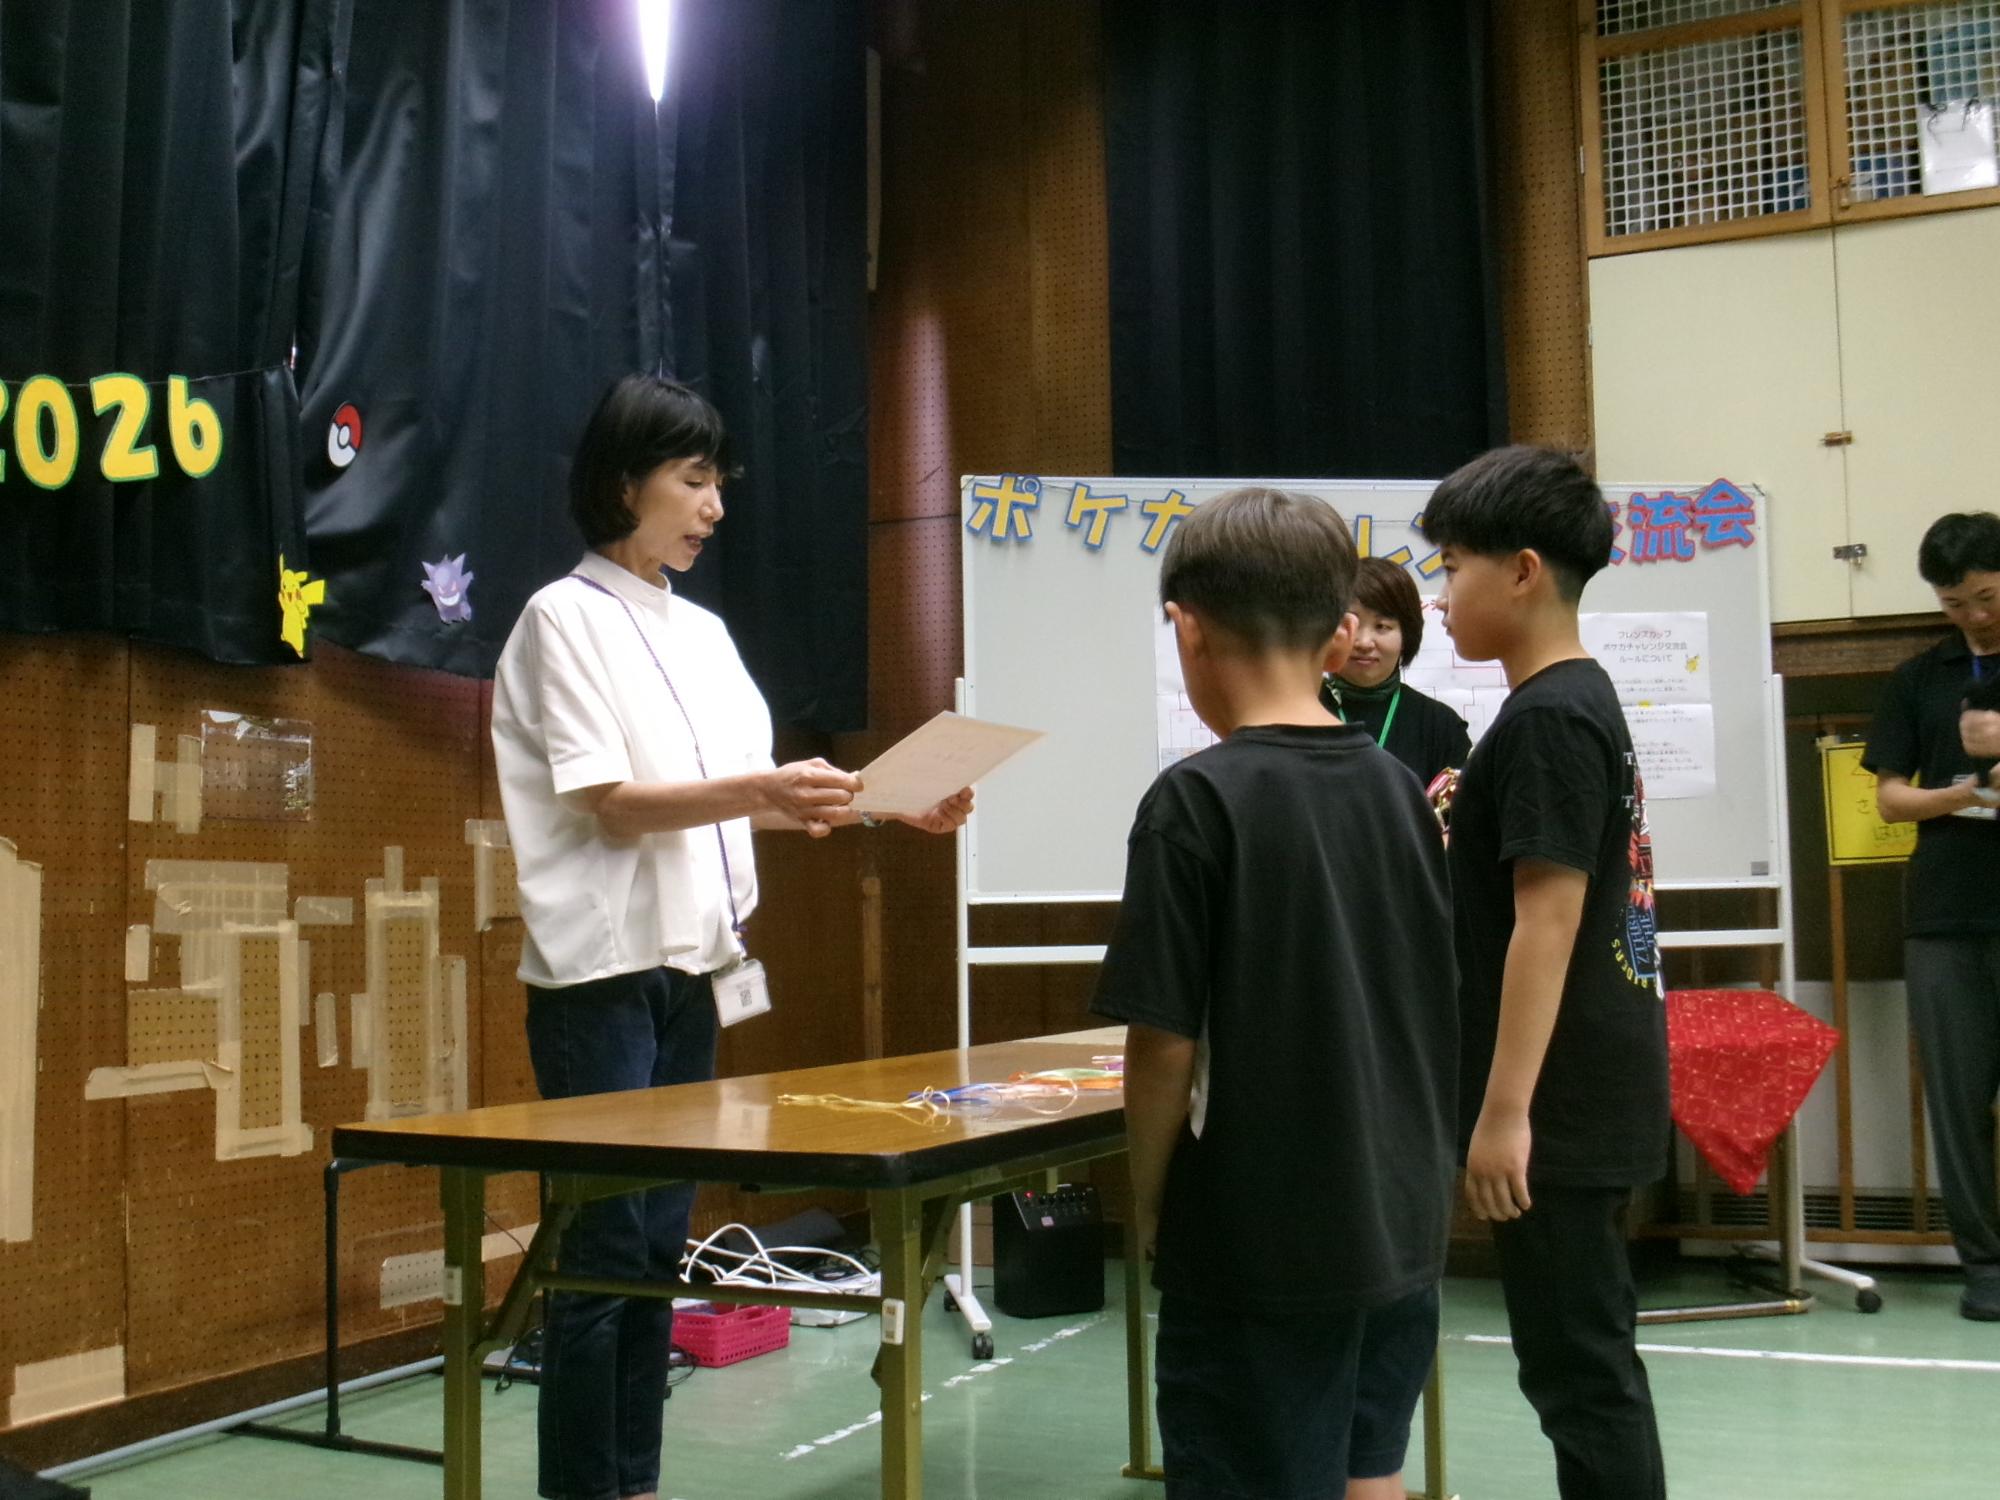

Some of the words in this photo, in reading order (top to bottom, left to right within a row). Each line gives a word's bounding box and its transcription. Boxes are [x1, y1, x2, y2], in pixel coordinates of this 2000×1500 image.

[0, 373, 223, 490] 026
[1619, 653, 1673, 664] ルールについて
